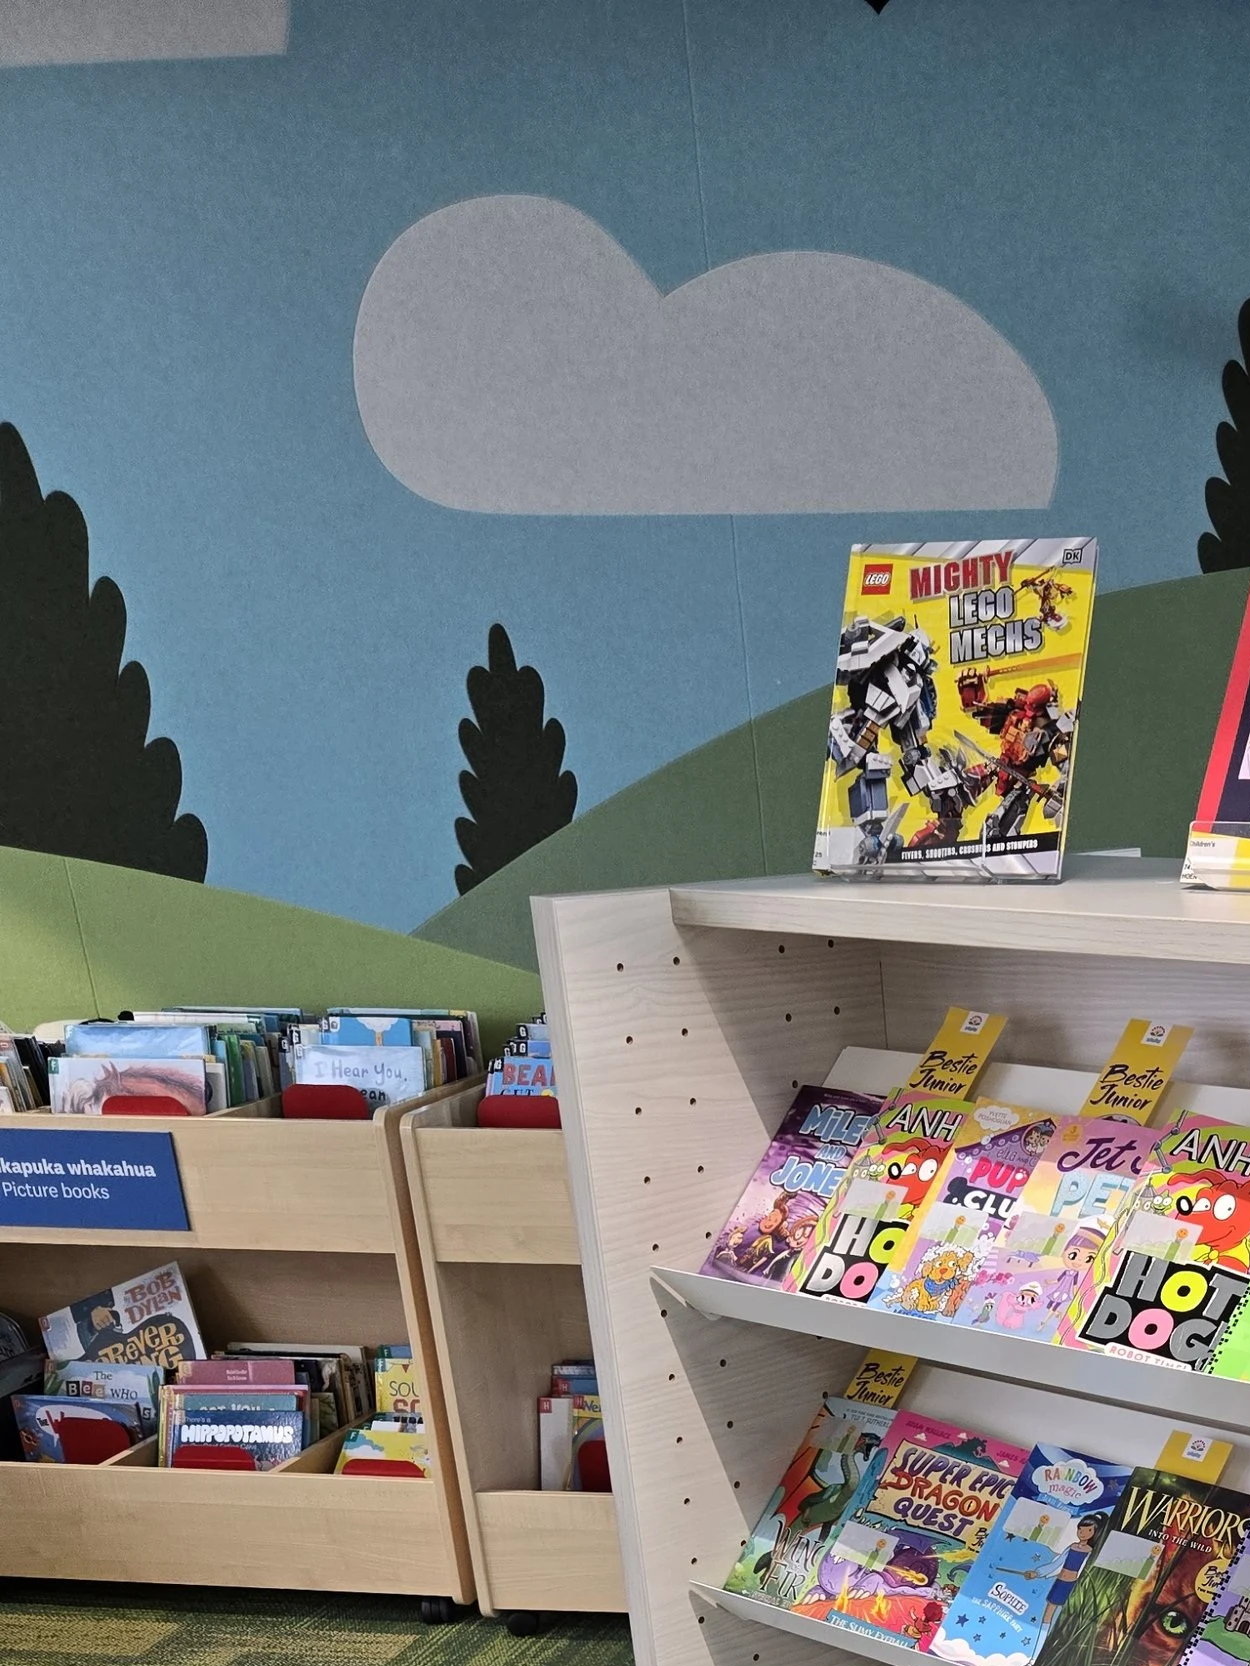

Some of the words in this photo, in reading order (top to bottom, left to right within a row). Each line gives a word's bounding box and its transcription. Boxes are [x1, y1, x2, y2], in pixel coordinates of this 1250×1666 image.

[1064, 549, 1082, 563] DK
[864, 572, 891, 587] LEGO
[909, 551, 1014, 599] MIGHTY
[950, 587, 1015, 628] LEGO
[950, 617, 1043, 663] MECHS
[332, 1059, 369, 1079] Hear
[918, 1048, 979, 1076] Bestie
[909, 1067, 968, 1095] Junior
[1101, 1064, 1165, 1092] Bestie
[1090, 1083, 1153, 1111] Junior
[887, 1103, 964, 1142] ANH
[814, 1143, 848, 1163] AND
[1057, 1137, 1137, 1173] Jet
[0, 1157, 65, 1177] kapuka
[67, 1159, 157, 1178] whakahua
[970, 1156, 1029, 1194] PUP
[2, 1181, 59, 1198] Picture
[61, 1183, 110, 1200] books
[124, 1271, 176, 1303] BOB
[1115, 1252, 1250, 1320] HOT
[1109, 1346, 1151, 1363] ROBOT
[94, 1371, 113, 1381] The
[856, 1362, 905, 1388] Bestie
[67, 1382, 105, 1397] Bee
[110, 1388, 138, 1400] WHO
[846, 1380, 894, 1405] Junior
[180, 1424, 294, 1444] HIPPOPOTAMUS
[899, 1447, 968, 1489] SUPER
[969, 1472, 1016, 1499] EPIC
[1045, 1466, 1099, 1495] RAINBOW
[880, 1472, 1000, 1521] DRAGON
[1049, 1482, 1082, 1500] magic
[894, 1496, 974, 1537] QUEST
[1148, 1529, 1169, 1541] INTO
[1171, 1535, 1188, 1547] THE
[1190, 1541, 1212, 1553] WILD
